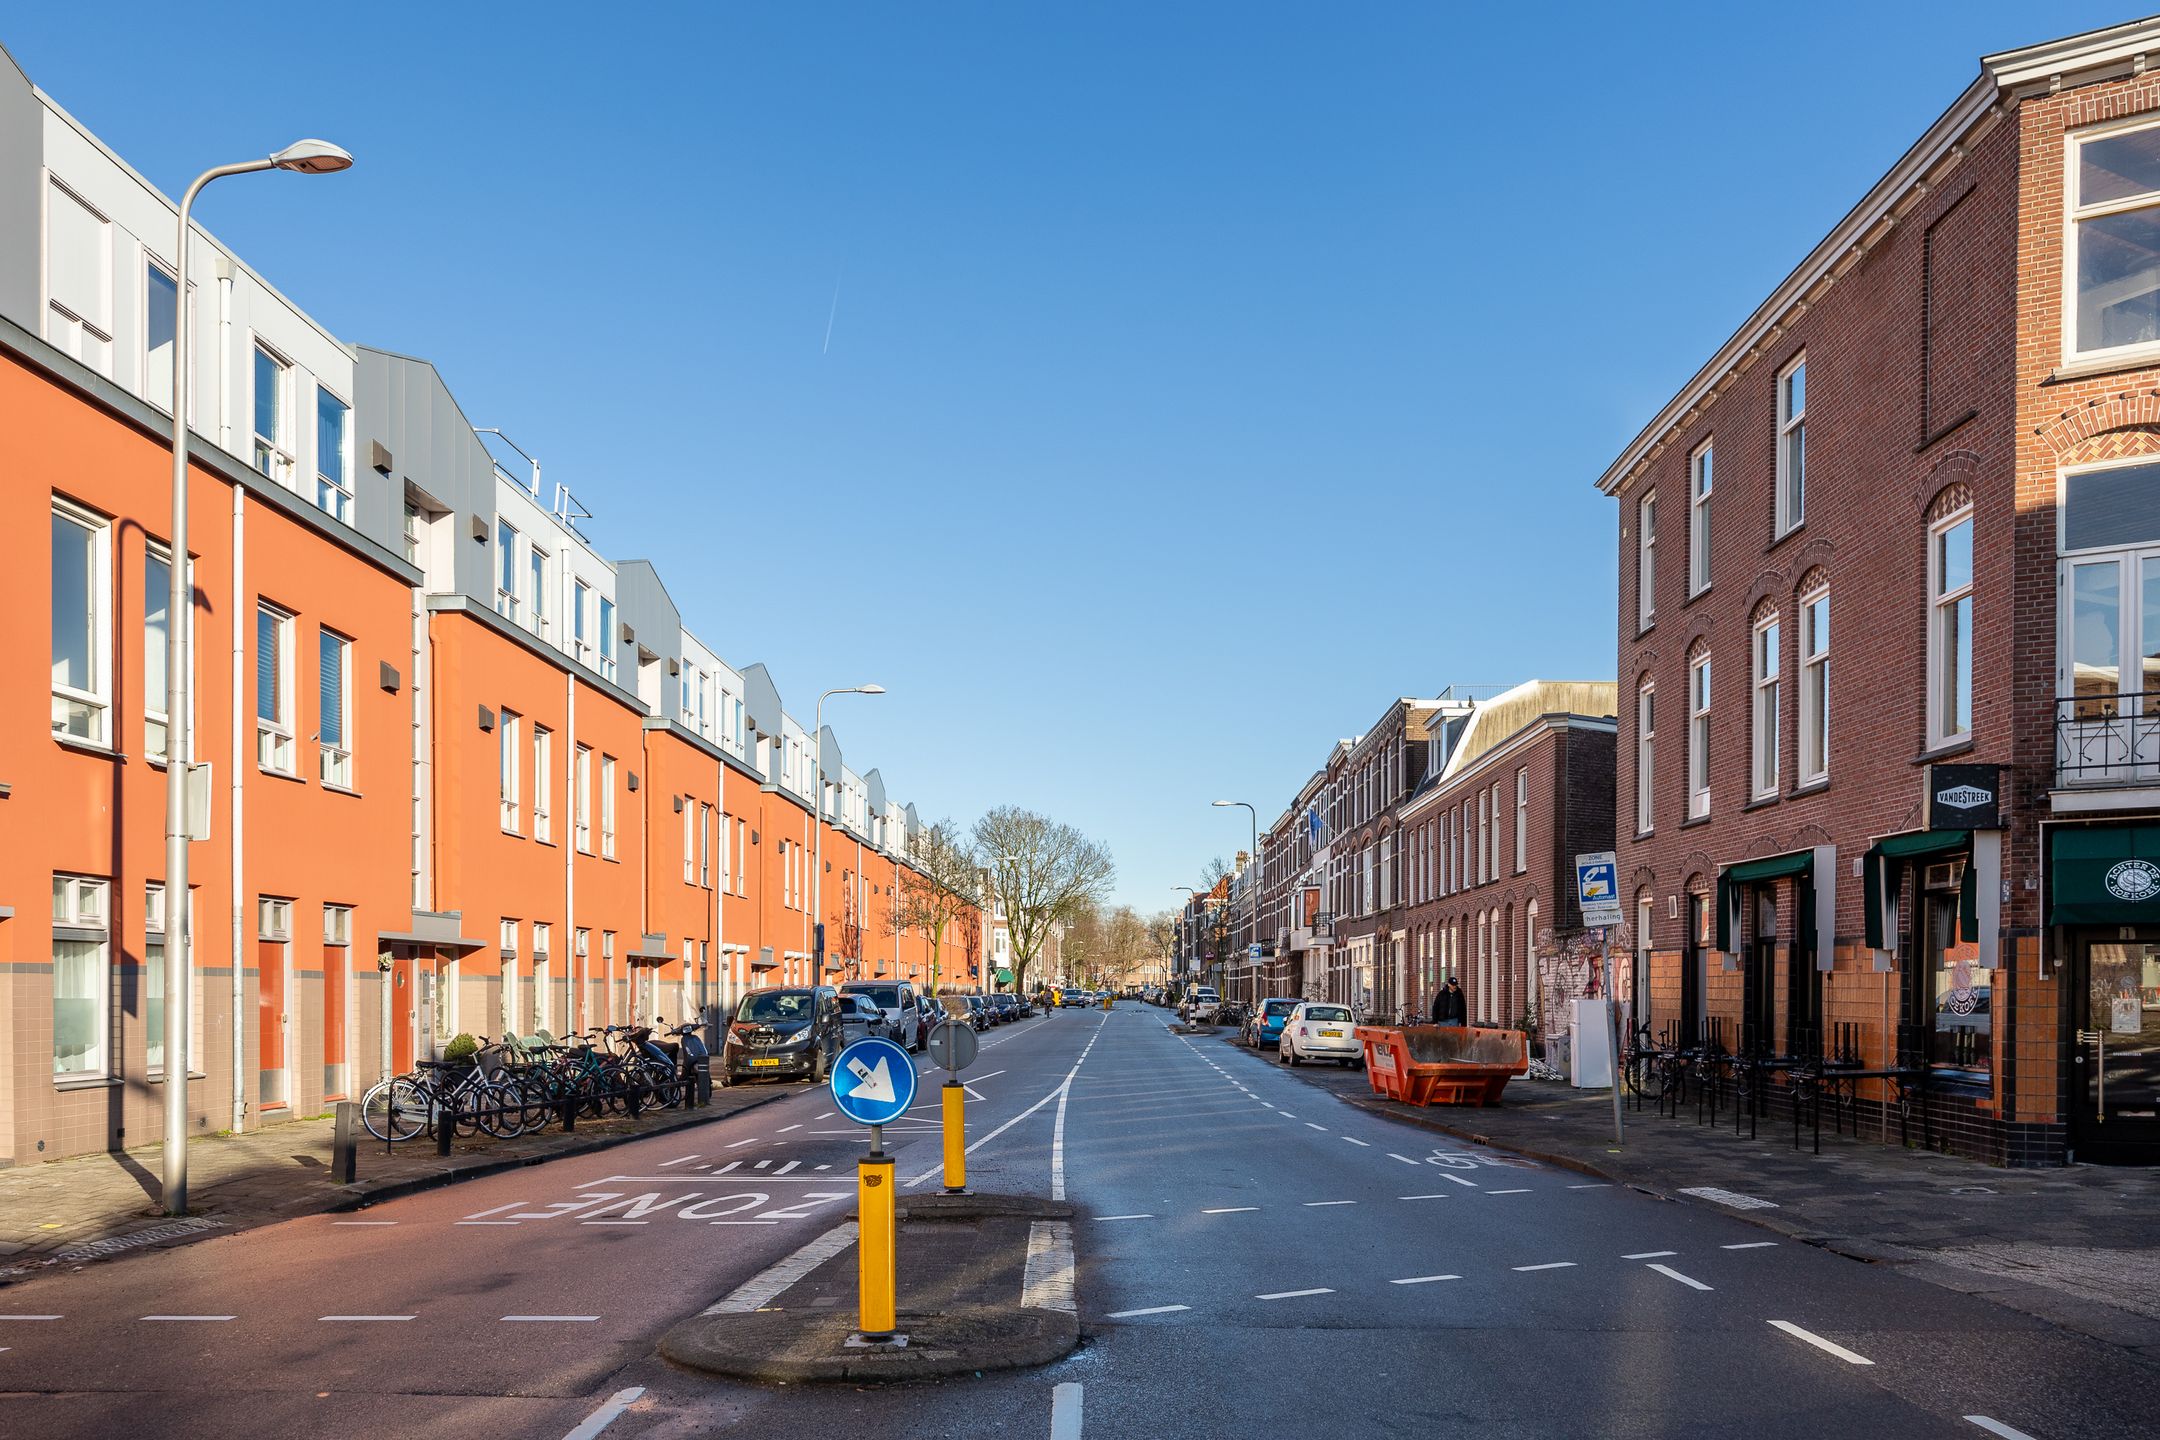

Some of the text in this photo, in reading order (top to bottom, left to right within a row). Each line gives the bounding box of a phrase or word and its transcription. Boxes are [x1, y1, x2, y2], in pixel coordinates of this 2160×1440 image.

[1939, 790, 1990, 804] VANDESTREEK
[2109, 862, 2160, 880] ACHTER DE
[2110, 883, 2160, 899] KOEKOEK
[1586, 914, 1621, 923] herhaling
